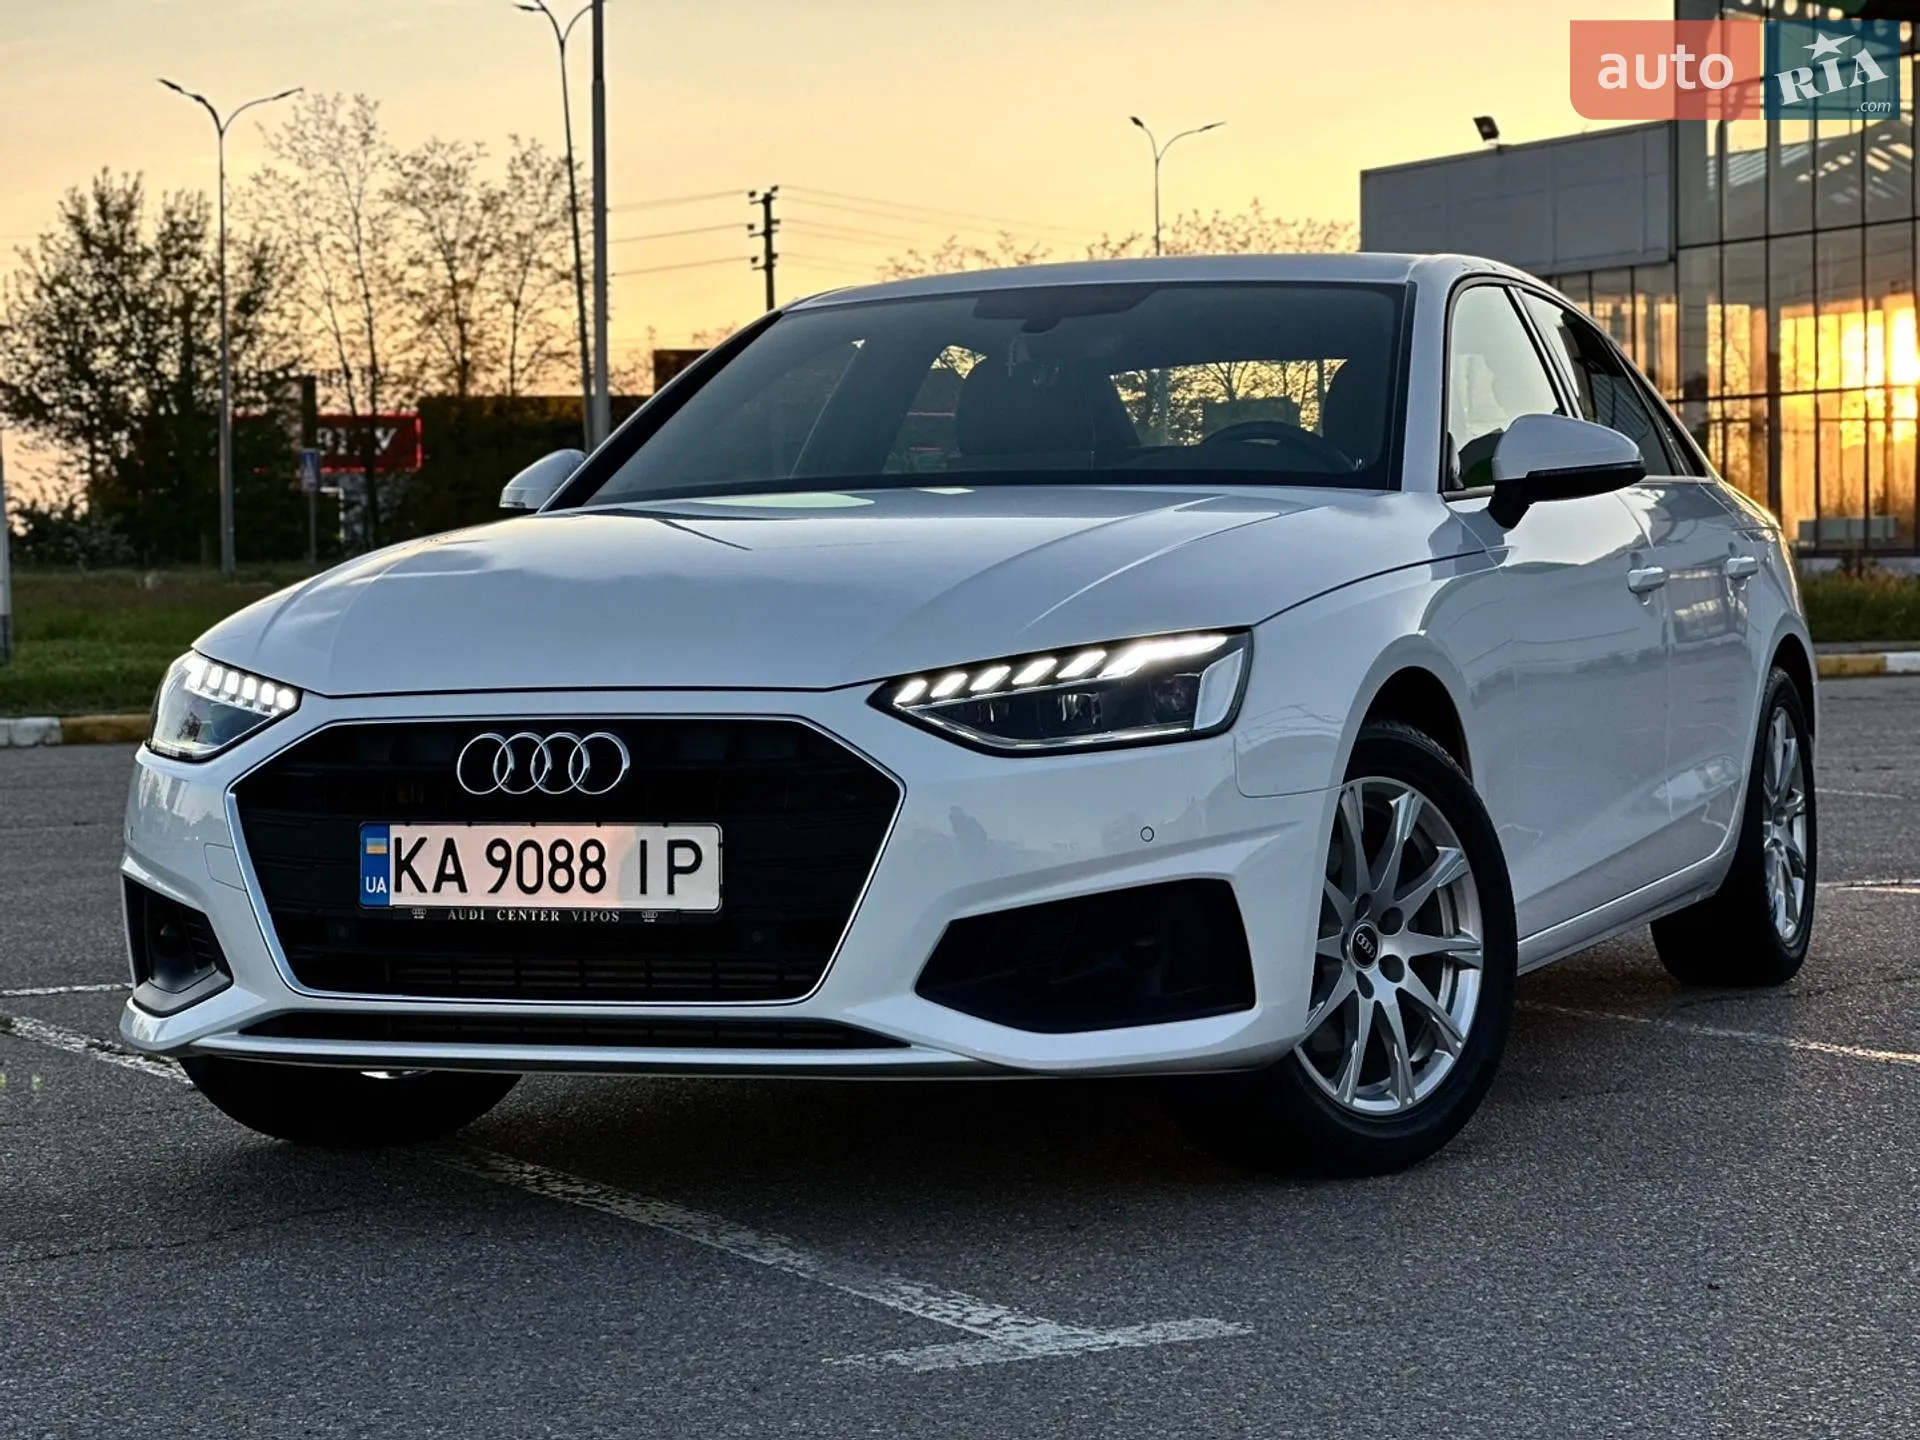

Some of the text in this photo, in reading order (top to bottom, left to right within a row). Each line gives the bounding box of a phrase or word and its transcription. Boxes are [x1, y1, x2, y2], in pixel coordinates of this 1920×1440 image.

[394, 836, 703, 896] KA 9088 IP
[365, 875, 388, 894] UA
[448, 909, 620, 923] AUDI CENTER VIPOS
